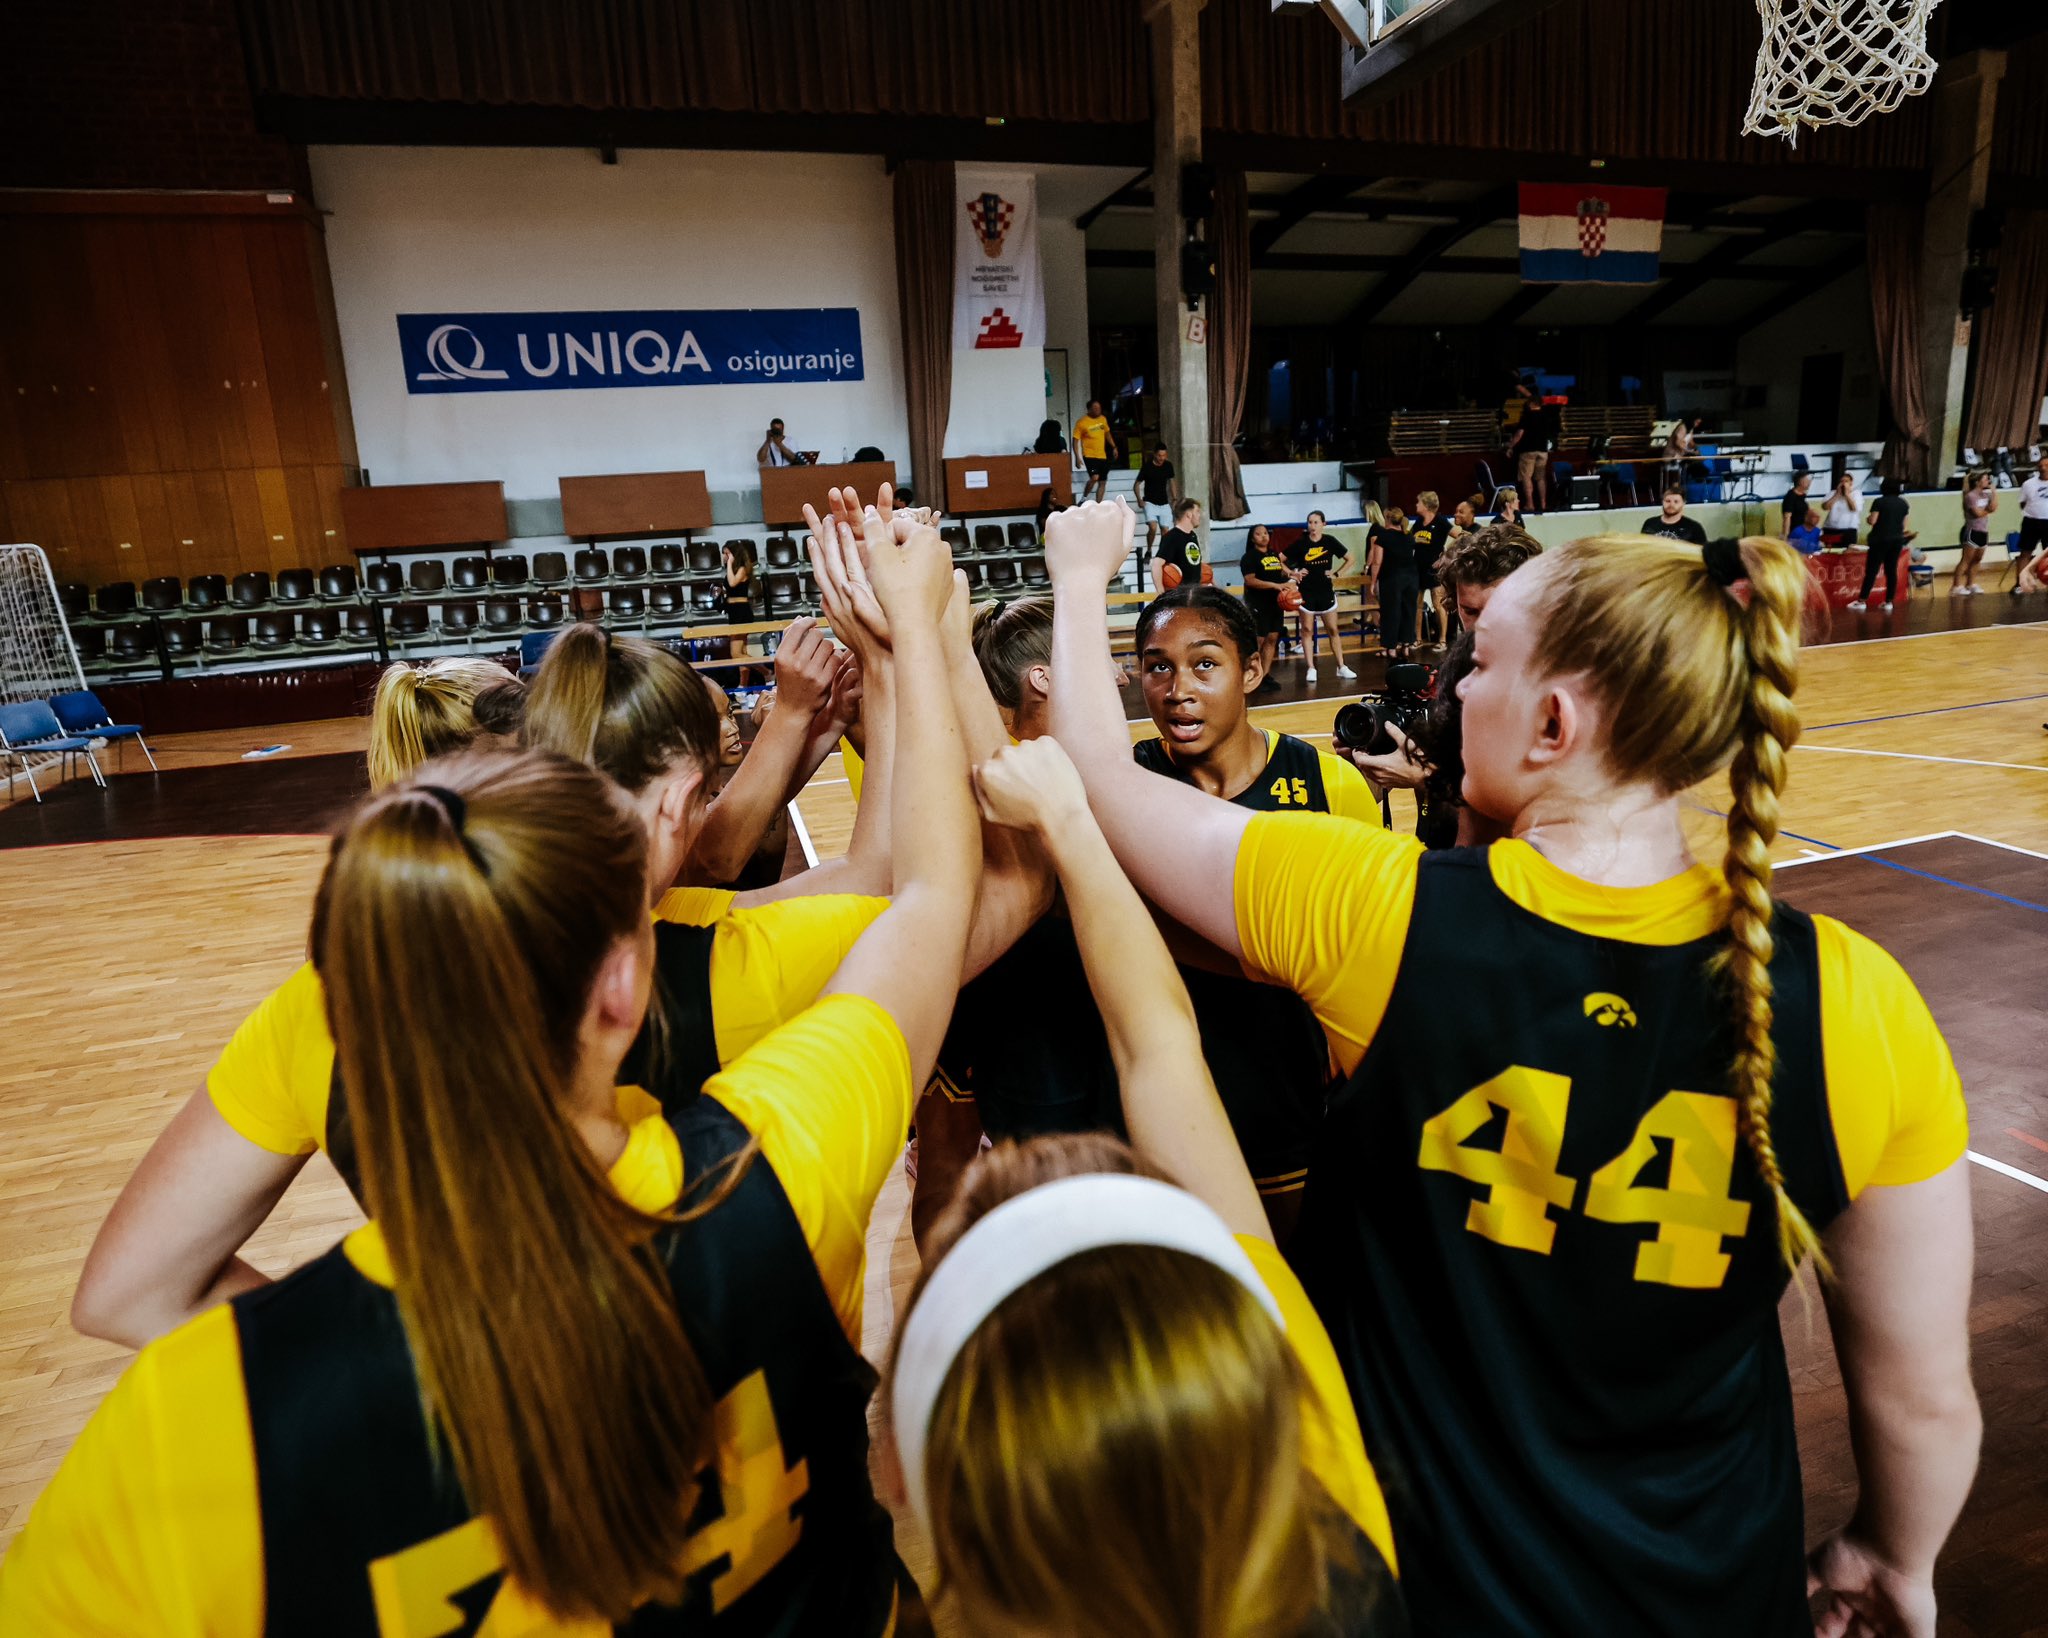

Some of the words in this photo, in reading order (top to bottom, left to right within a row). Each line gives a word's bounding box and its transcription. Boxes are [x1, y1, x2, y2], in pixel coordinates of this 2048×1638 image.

[517, 329, 712, 378] UNIQA
[727, 347, 855, 377] osiguranje
[1270, 777, 1308, 806] 45
[1418, 1064, 1751, 1288] 44
